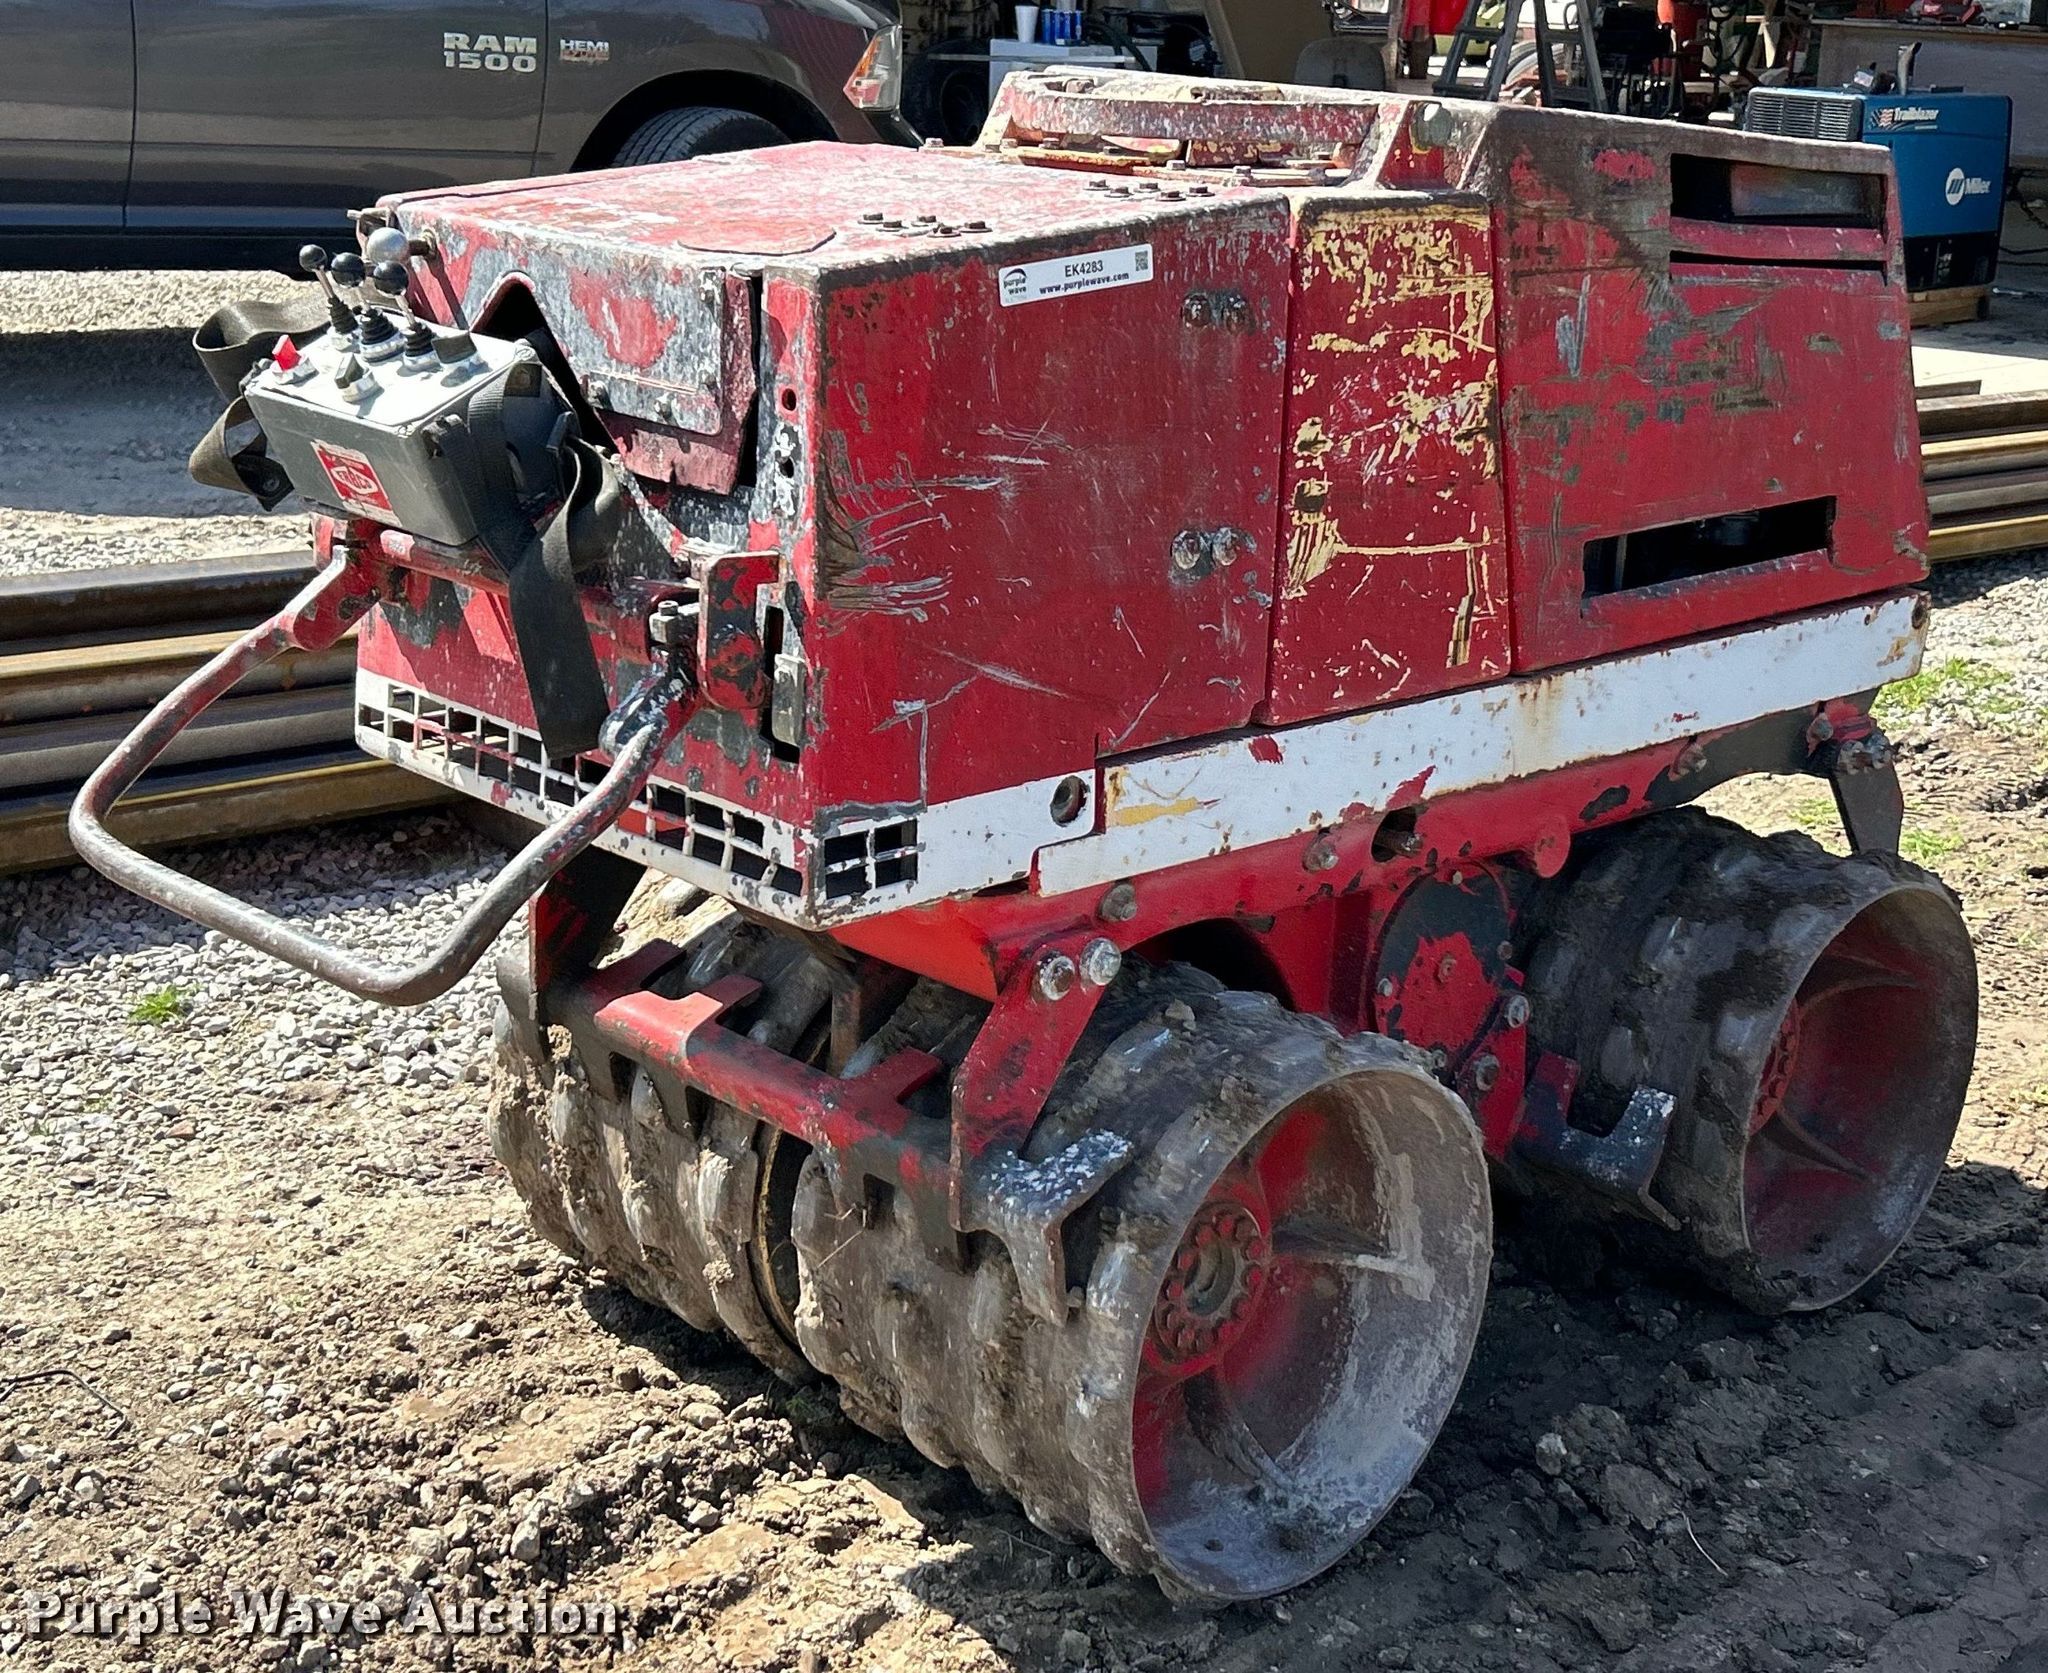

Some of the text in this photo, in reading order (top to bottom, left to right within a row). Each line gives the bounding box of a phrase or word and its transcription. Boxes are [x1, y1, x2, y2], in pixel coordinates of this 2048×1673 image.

[444, 32, 537, 54] RAM
[560, 39, 609, 52] HEMI
[444, 51, 537, 73] 1500
[1065, 260, 1104, 277] EK4283
[1004, 275, 1026, 289] purple
[1008, 286, 1027, 295] wave
[1039, 272, 1130, 295] www.purplewave.com
